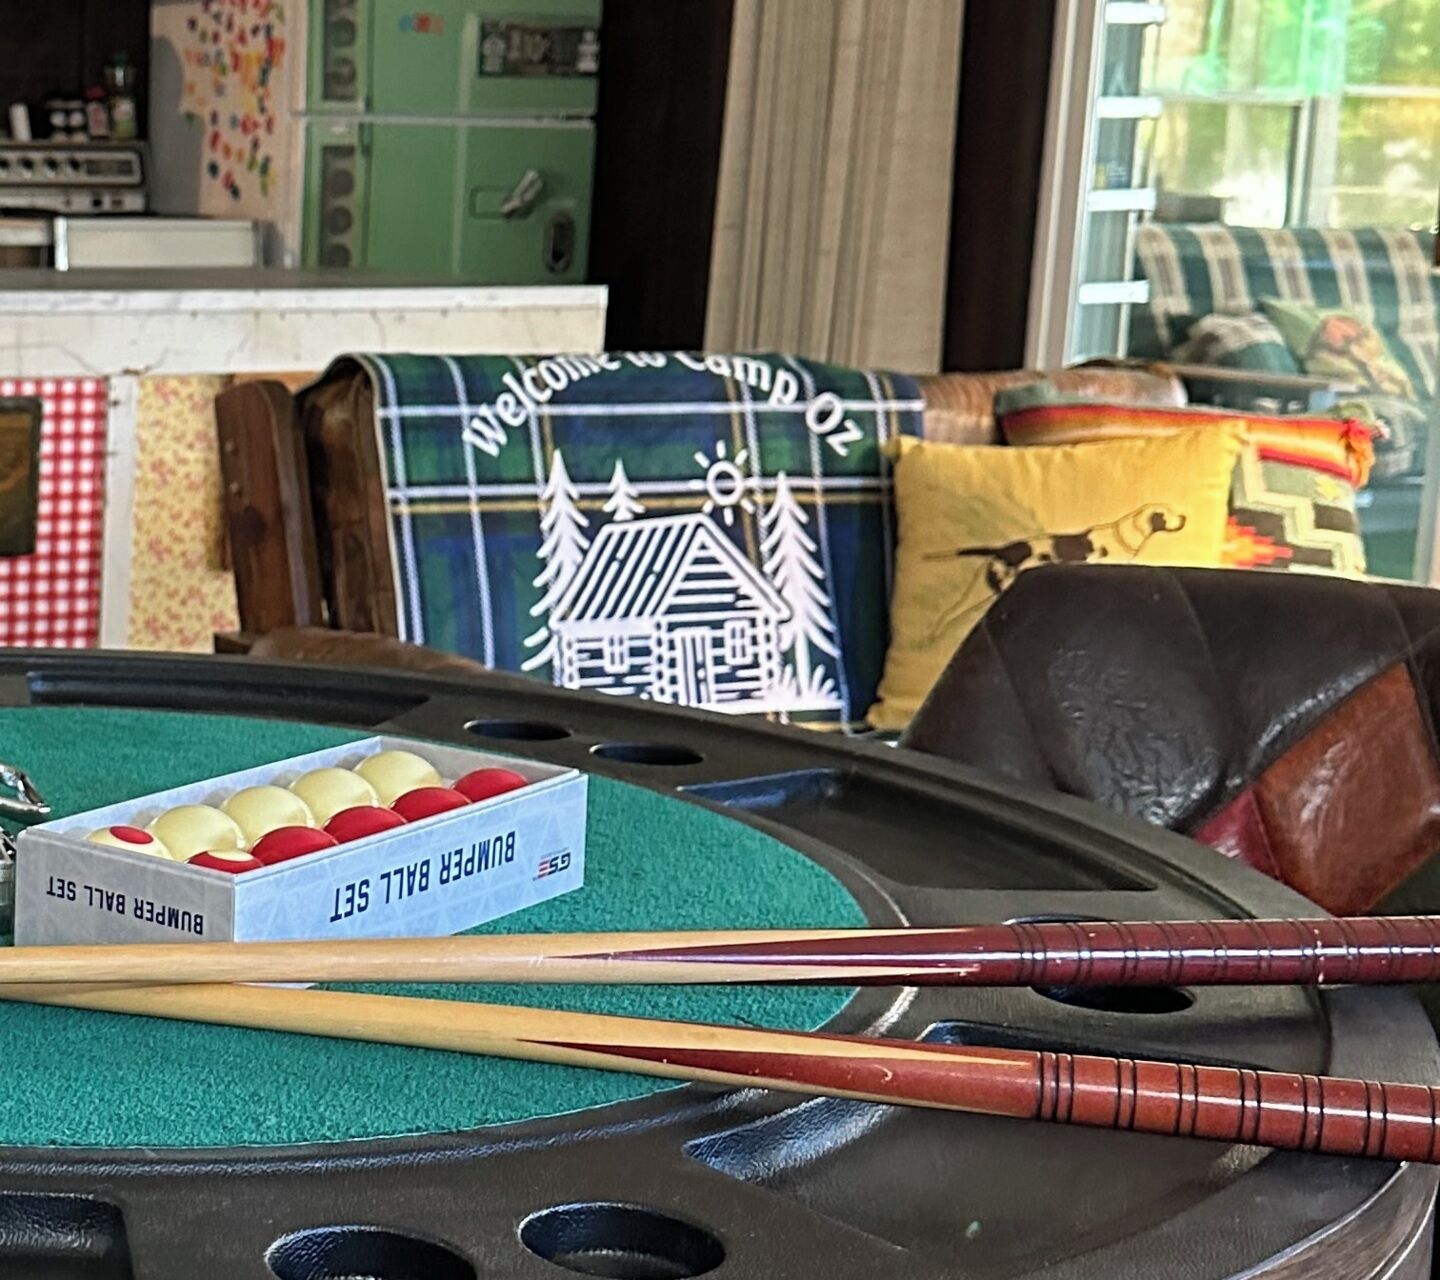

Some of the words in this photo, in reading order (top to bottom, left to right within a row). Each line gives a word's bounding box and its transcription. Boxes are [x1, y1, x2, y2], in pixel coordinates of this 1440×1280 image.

[462, 350, 621, 458] Welcome
[805, 392, 864, 457] Oz
[428, 830, 517, 885] BUMPER
[46, 876, 77, 902] SET
[83, 885, 126, 915] BALL
[329, 878, 370, 923] SET
[379, 858, 431, 904] BALL
[134, 897, 204, 936] BUMPER
